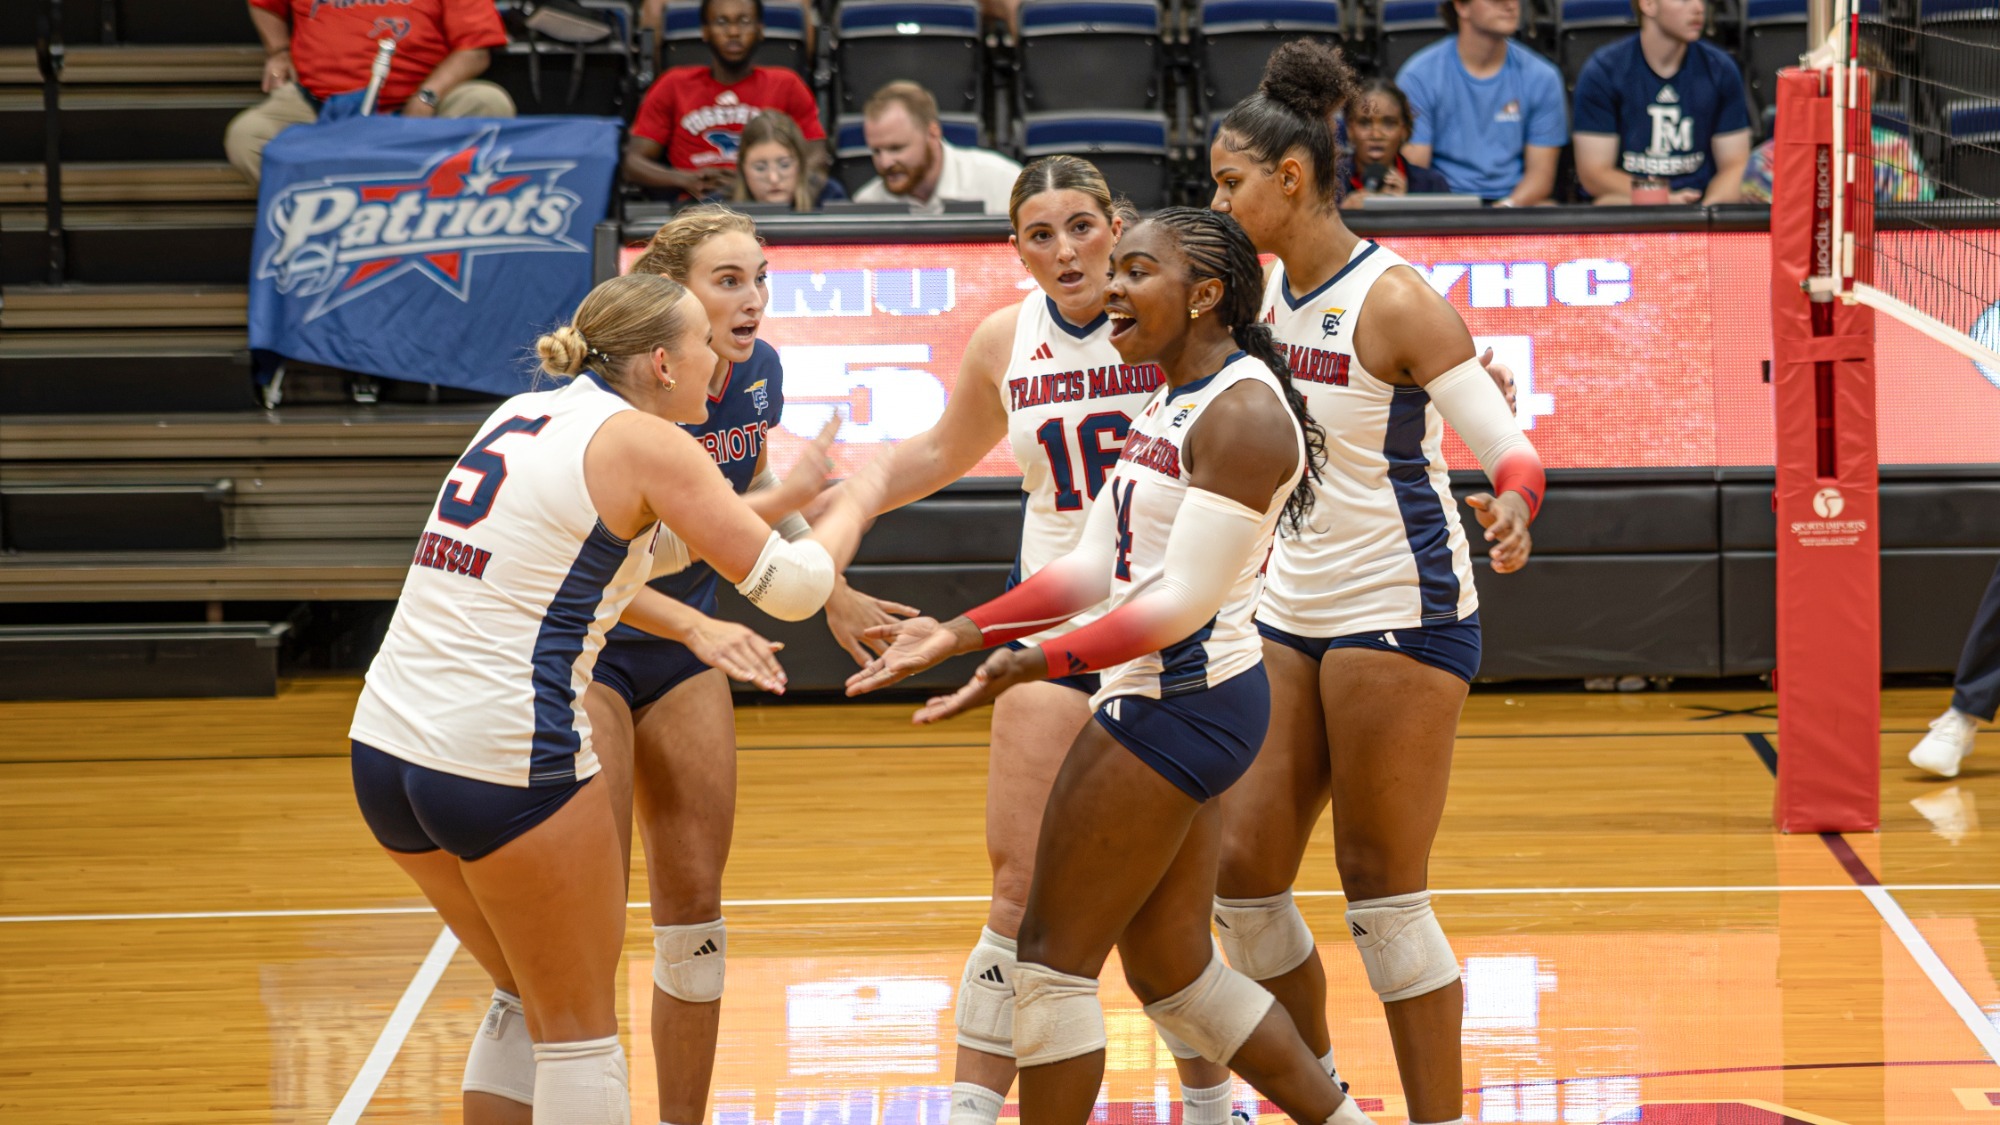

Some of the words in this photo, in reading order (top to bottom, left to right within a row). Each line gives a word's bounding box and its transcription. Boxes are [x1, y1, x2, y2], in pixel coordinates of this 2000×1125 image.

[272, 186, 570, 266] Patriots
[779, 343, 948, 443] 5
[1008, 370, 1085, 412] FRANCIS
[1288, 344, 1352, 388] MARION
[437, 414, 553, 530] 5
